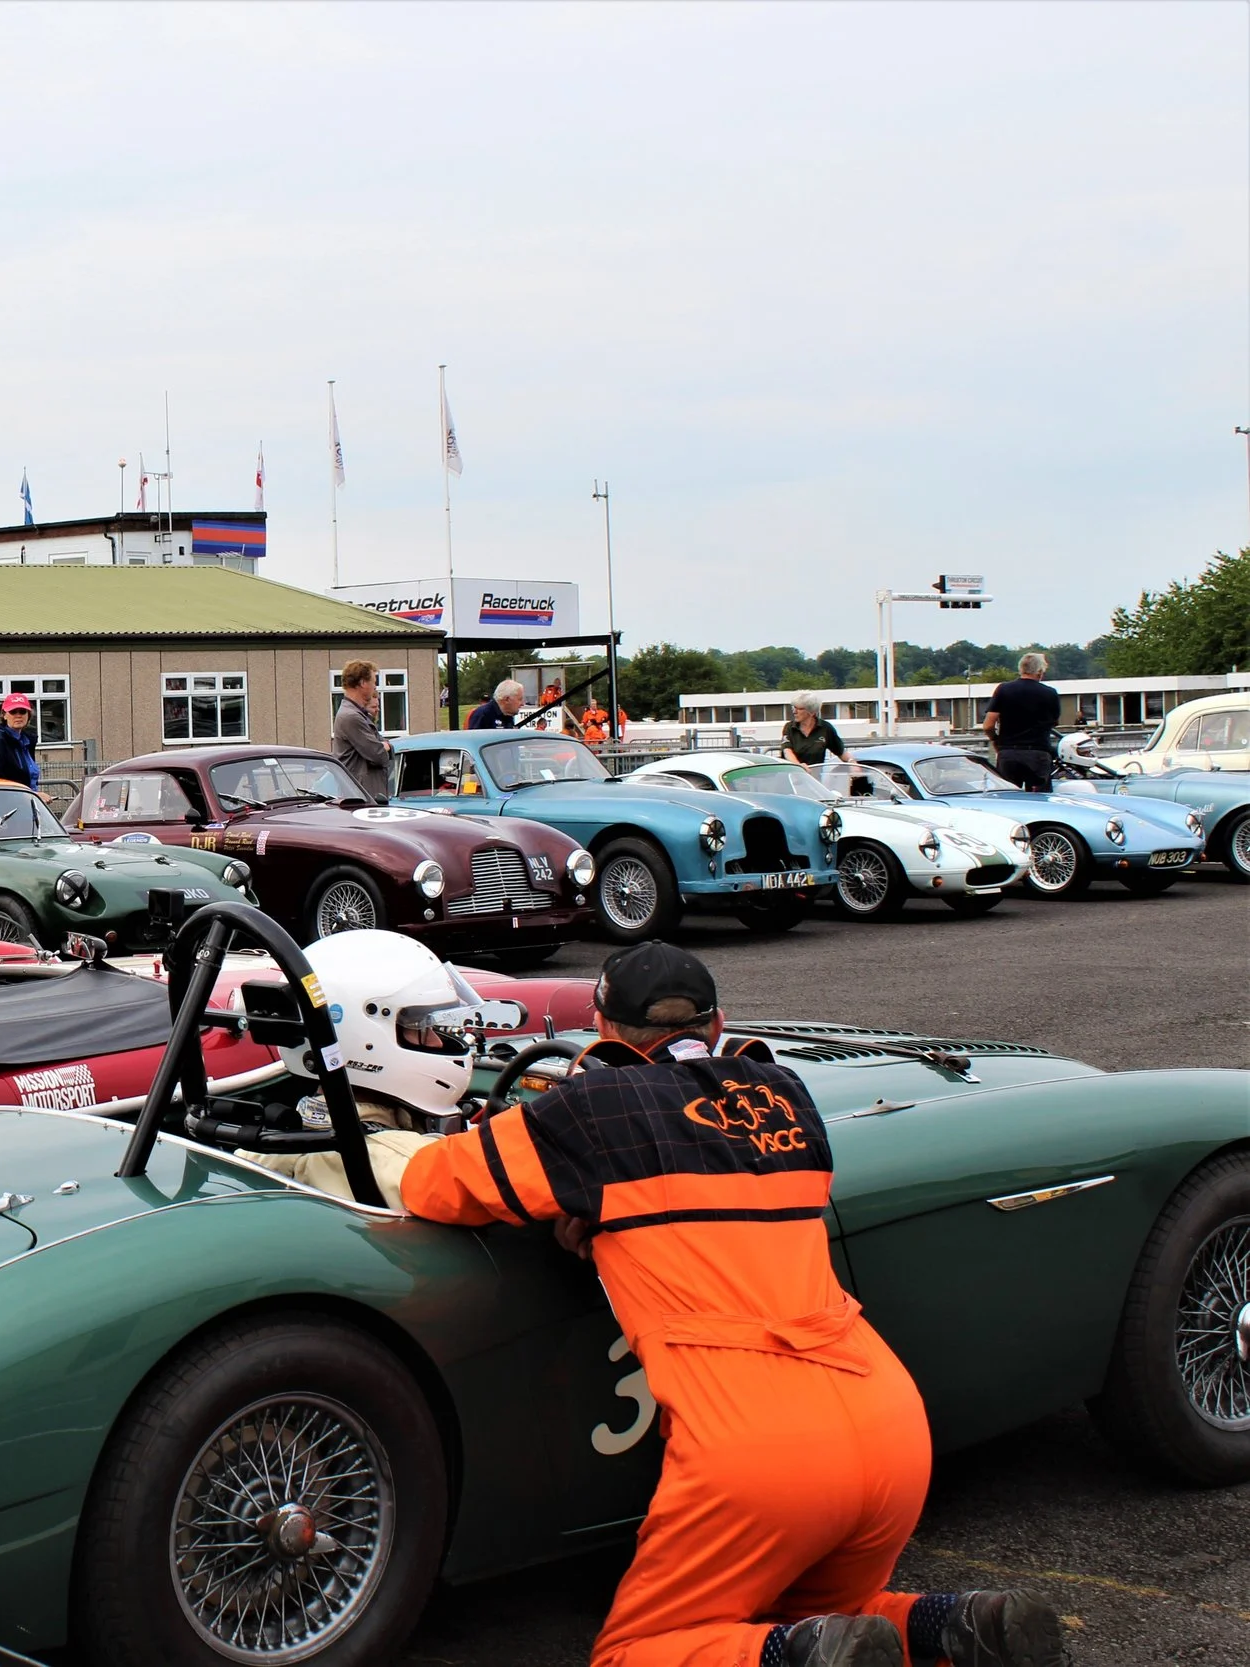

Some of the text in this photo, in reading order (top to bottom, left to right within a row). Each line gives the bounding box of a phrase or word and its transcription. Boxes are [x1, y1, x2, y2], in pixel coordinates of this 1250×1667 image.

[347, 592, 446, 613] etruck
[481, 593, 555, 611] Racetruck
[519, 710, 558, 719] THRTON
[525, 720, 552, 728] CIRT
[366, 808, 418, 819] 53
[943, 832, 989, 848] 40
[528, 856, 549, 870] NLV
[1167, 851, 1186, 864] 303
[533, 868, 554, 881] 242
[787, 871, 808, 888] 442
[12, 1068, 64, 1094] MISSION
[21, 1082, 97, 1111] MOTORSPORT
[750, 1126, 807, 1155] VSCC
[591, 1334, 657, 1455] 3
